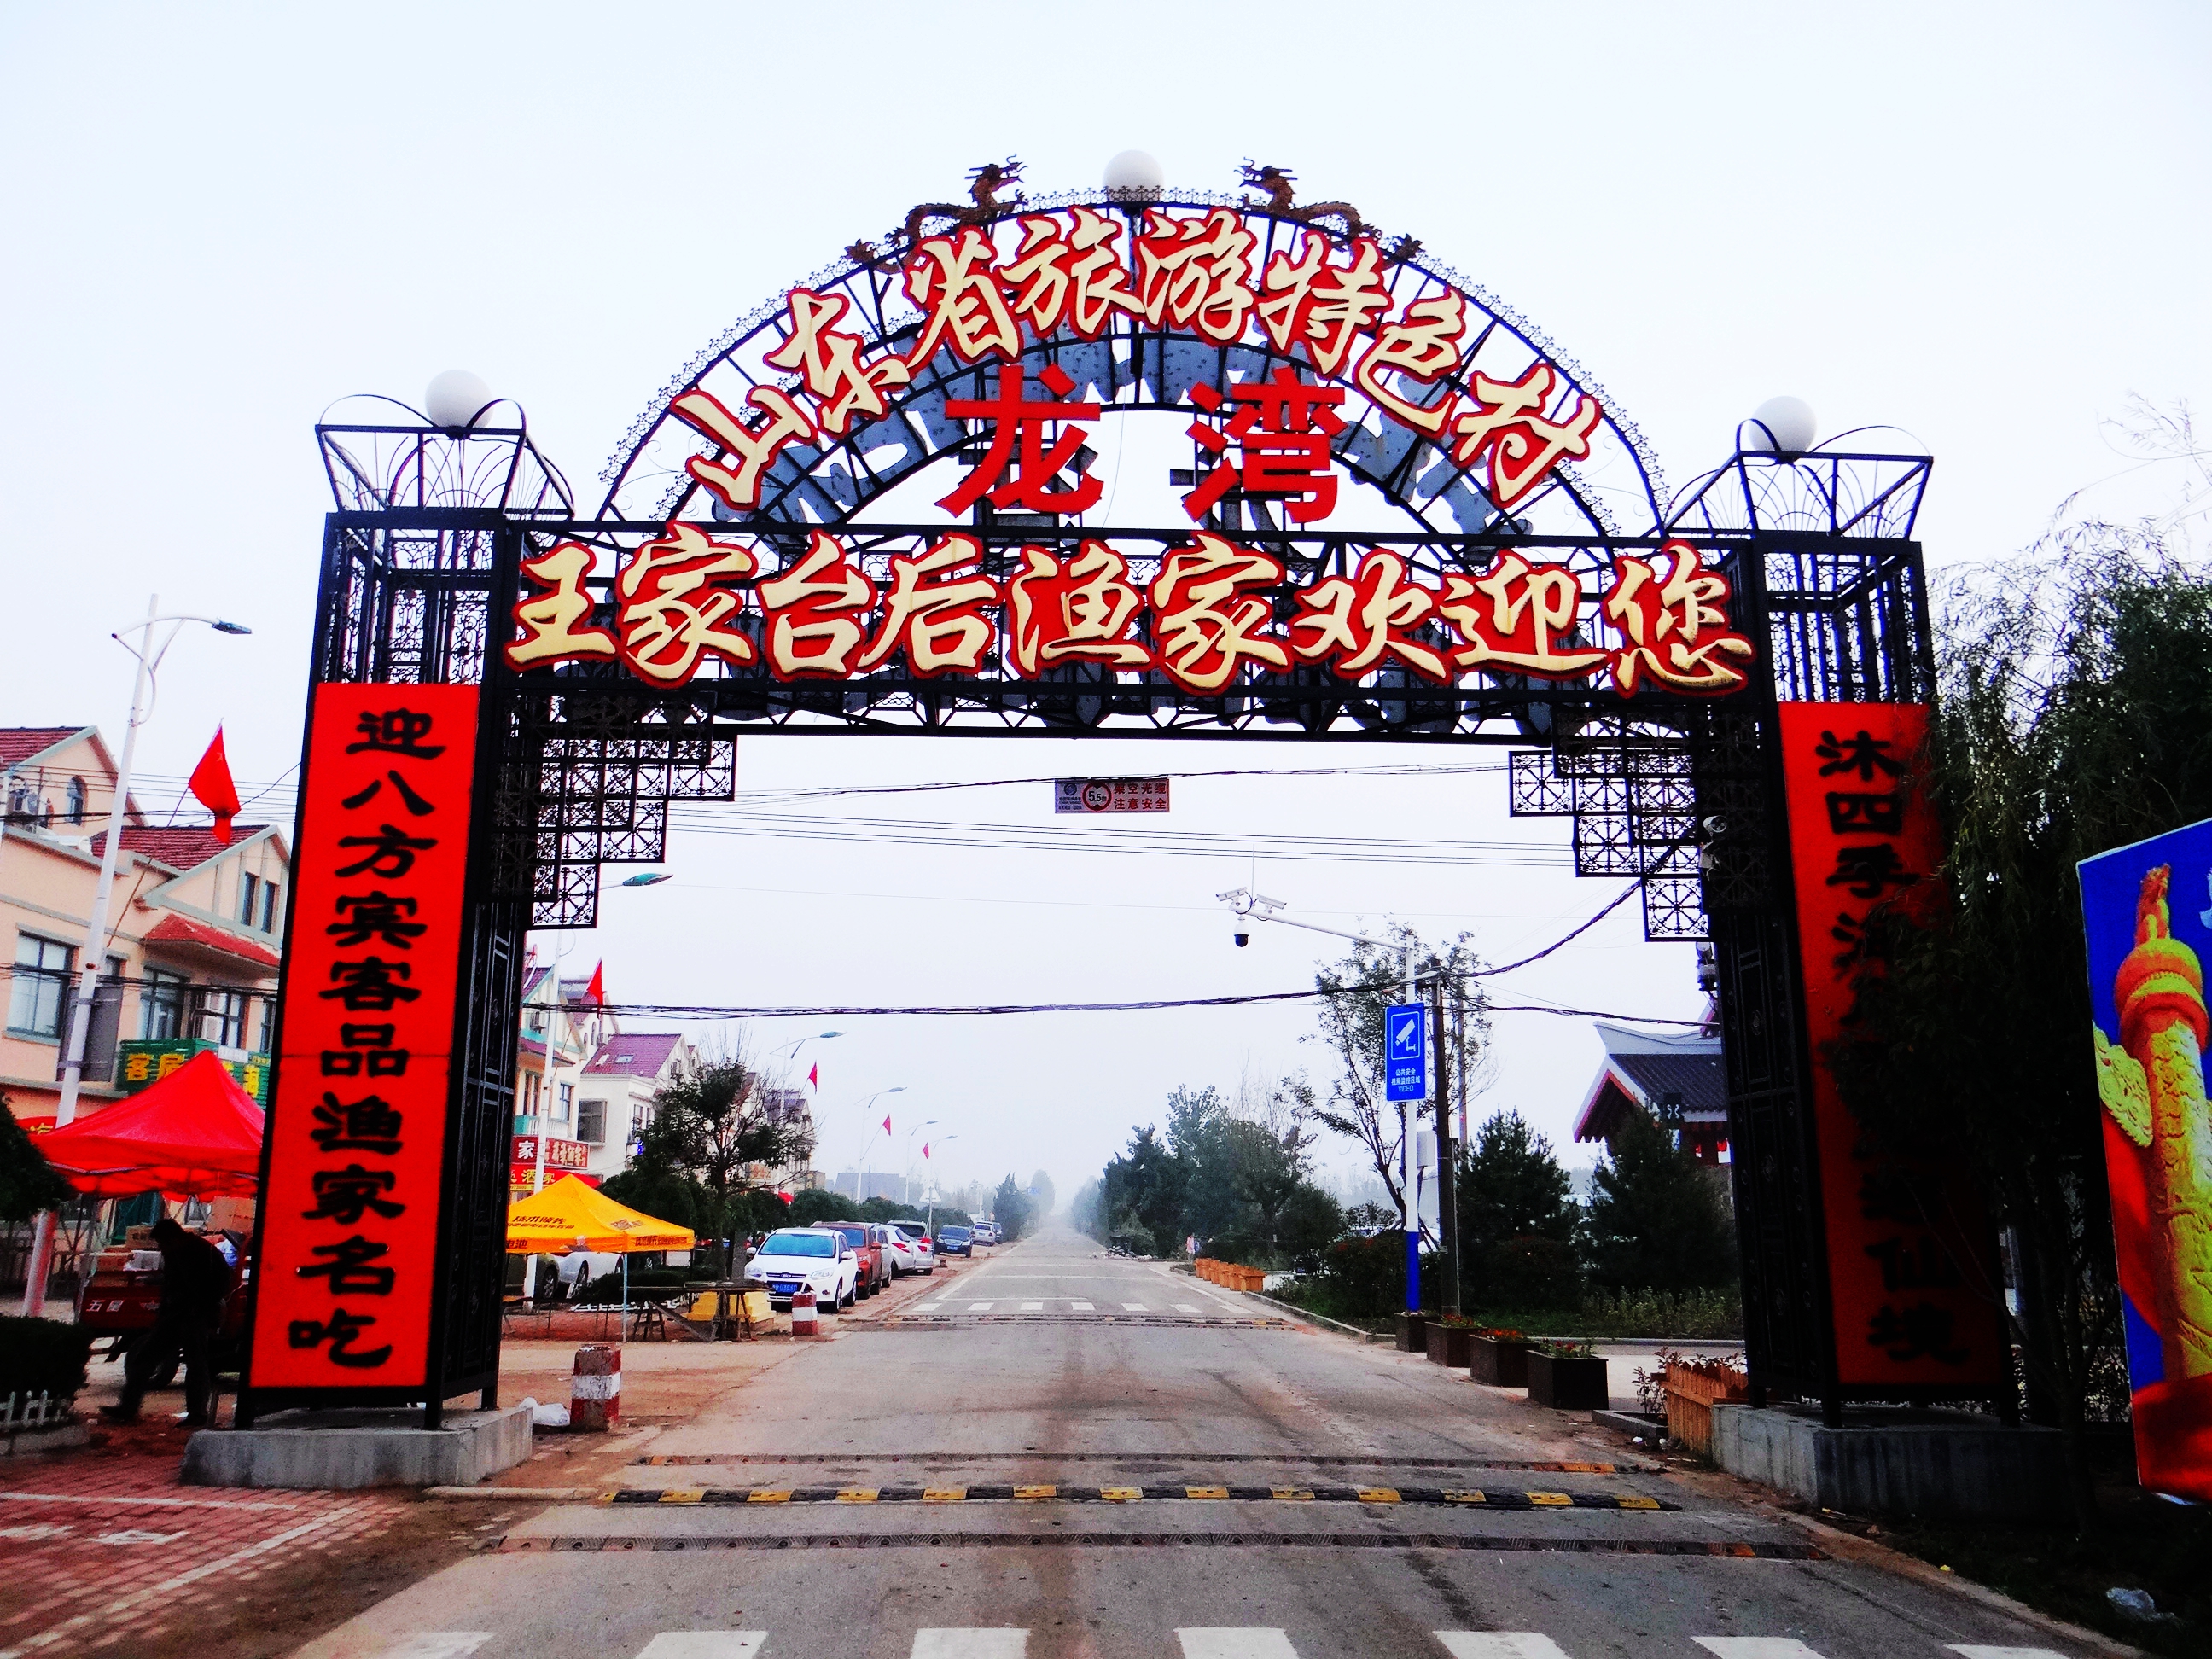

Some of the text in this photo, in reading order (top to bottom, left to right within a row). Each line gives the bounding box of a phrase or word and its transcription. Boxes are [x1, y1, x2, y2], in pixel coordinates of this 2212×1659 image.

[672, 206, 1600, 509] 山东省旅游特色村
[936, 364, 1349, 524] 龙湾
[506, 521, 1755, 698] 王家台后渔家欢迎您
[1114, 783, 1167, 795] 架空光缆
[1114, 798, 1167, 810] 注意安全
[288, 707, 446, 1368] 迎八方宾客品渔家名吃
[1395, 1068, 1417, 1076] 公共安全
[518, 1140, 535, 1160] 家
[85, 1299, 125, 1313] 五星
